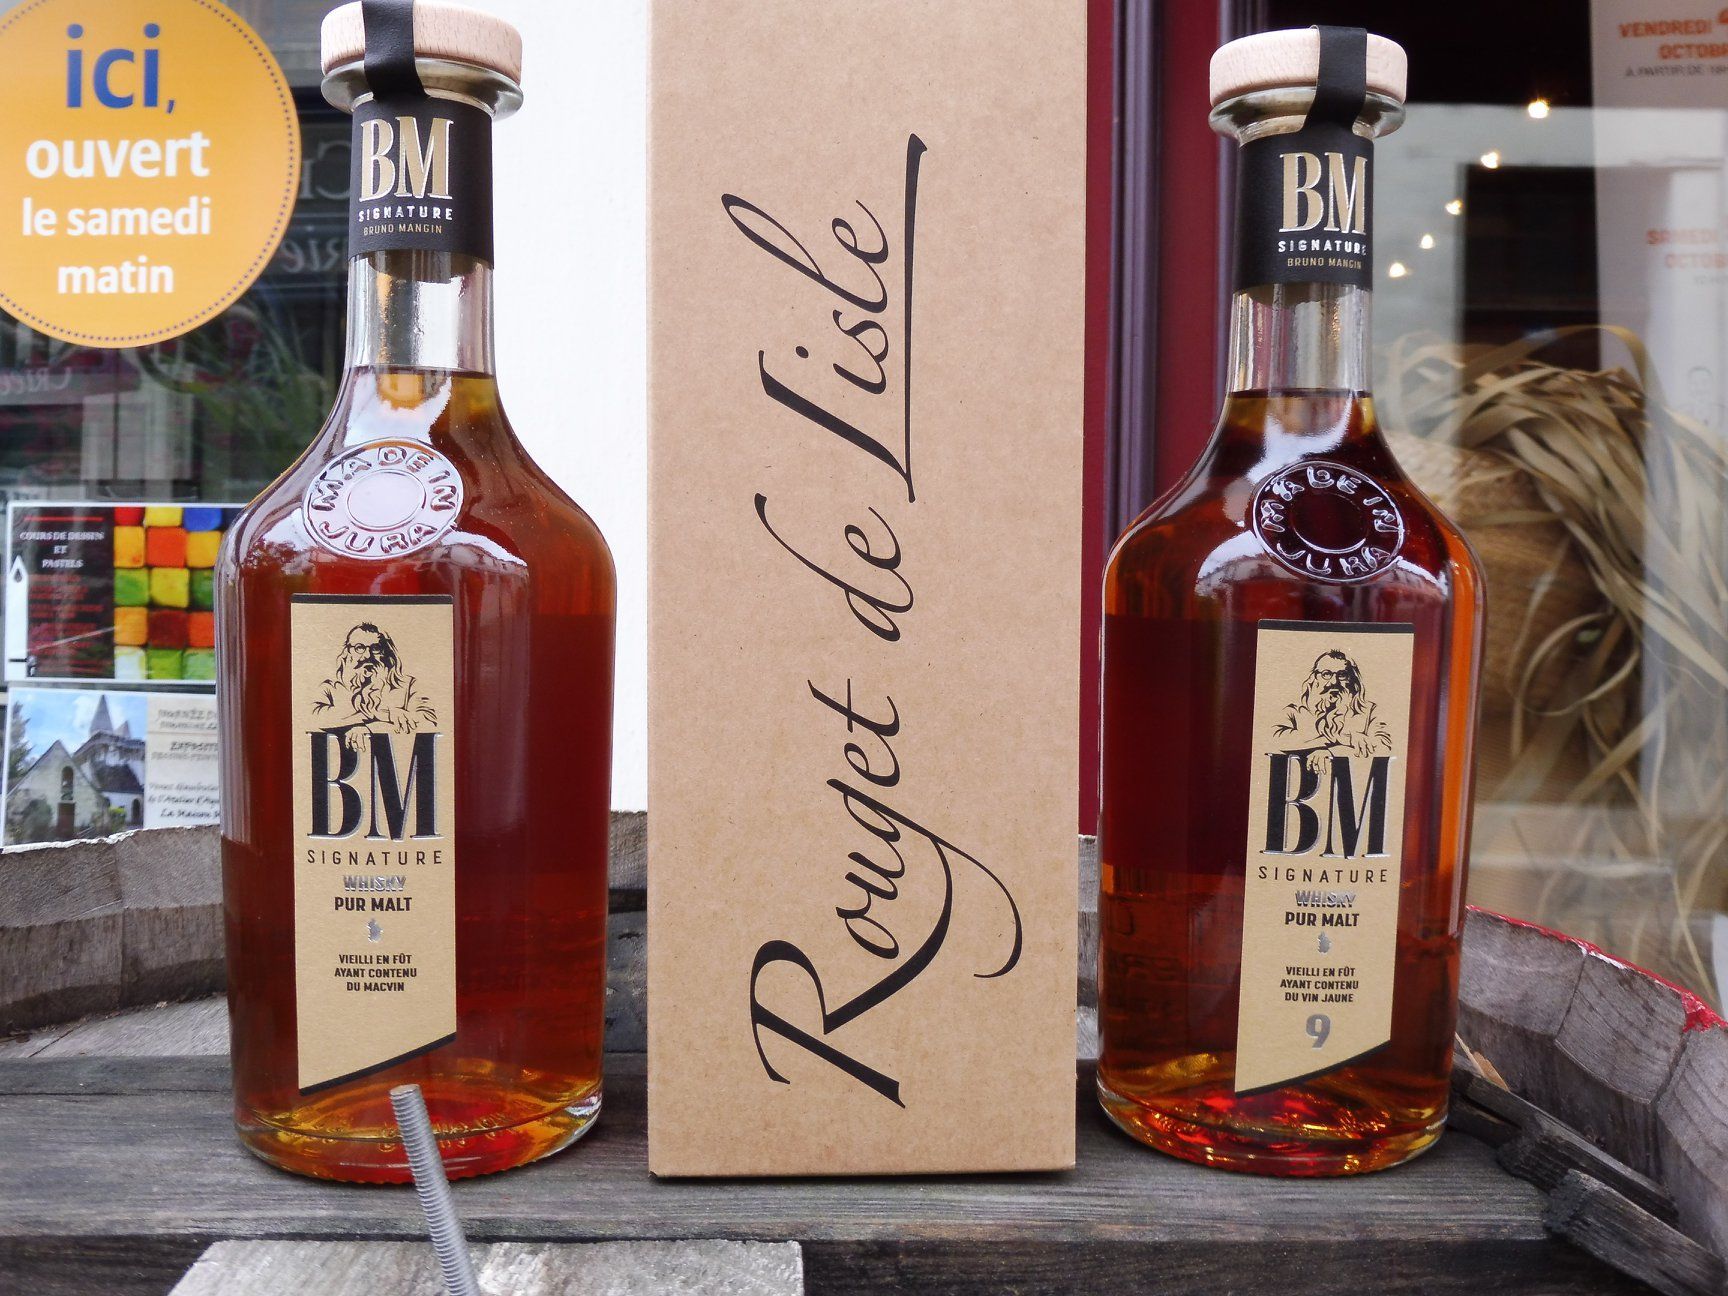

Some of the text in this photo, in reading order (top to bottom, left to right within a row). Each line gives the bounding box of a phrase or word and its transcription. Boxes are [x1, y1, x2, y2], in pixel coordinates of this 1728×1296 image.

[1618, 19, 1712, 38] VENDREDI
[66, 23, 175, 114] ici,
[25, 131, 211, 179] ouvert
[359, 116, 454, 202] BM
[1278, 151, 1369, 235] BM
[22, 196, 211, 236] le samedi
[358, 205, 453, 222] SIGNATURE
[363, 223, 443, 237] BRUNO MANGIN
[1278, 239, 1368, 256] SIGNATURE
[1287, 257, 1362, 270] BRUNO MANGIN
[57, 255, 174, 294] matin
[318, 520, 438, 554] JURA
[53, 545, 68, 554] ET
[1276, 542, 1391, 575] JURA
[754, 493, 914, 642] de
[305, 731, 445, 843] BM
[1259, 752, 1397, 860] BM
[307, 849, 442, 865] SIGNATURE
[1258, 866, 1388, 883] SIGNATURE
[343, 875, 407, 892] WHISKY
[750, 678, 1023, 1109] Rouget
[1295, 890, 1357, 908] WHISKY
[334, 896, 413, 912] PUR MALT
[1284, 911, 1360, 927] PUR MALT
[338, 952, 412, 965] VIEILLI EN FÛT
[334, 967, 417, 979] AYANT CONTENU
[1286, 966, 1356, 977] VIEILLI EN FÛT
[346, 981, 405, 992] DU MACVIN
[1280, 978, 1359, 990] AYANT CONTENU
[1284, 992, 1354, 1003] DU VIN JAUNE
[1305, 1013, 1331, 1050] 9
